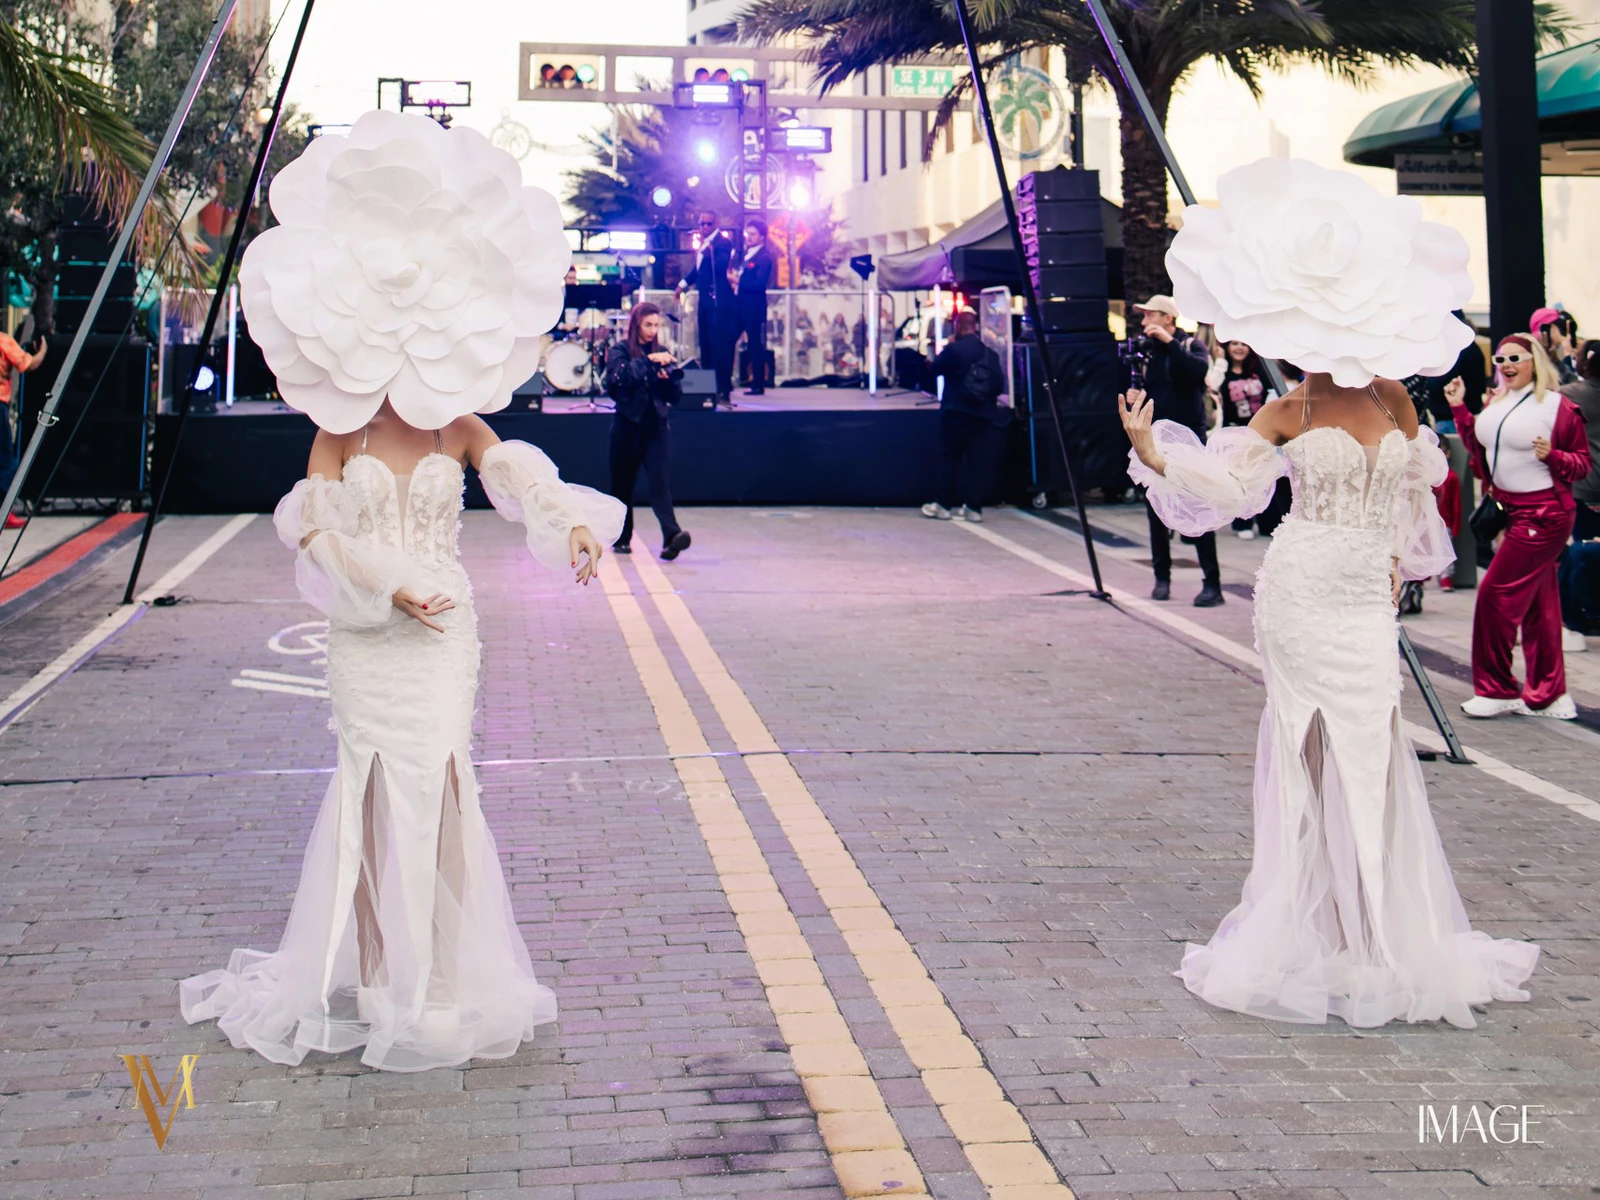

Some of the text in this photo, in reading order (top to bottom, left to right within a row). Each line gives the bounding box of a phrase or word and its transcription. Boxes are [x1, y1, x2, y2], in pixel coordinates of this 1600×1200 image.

[900, 69, 947, 85] SE 3 AV
